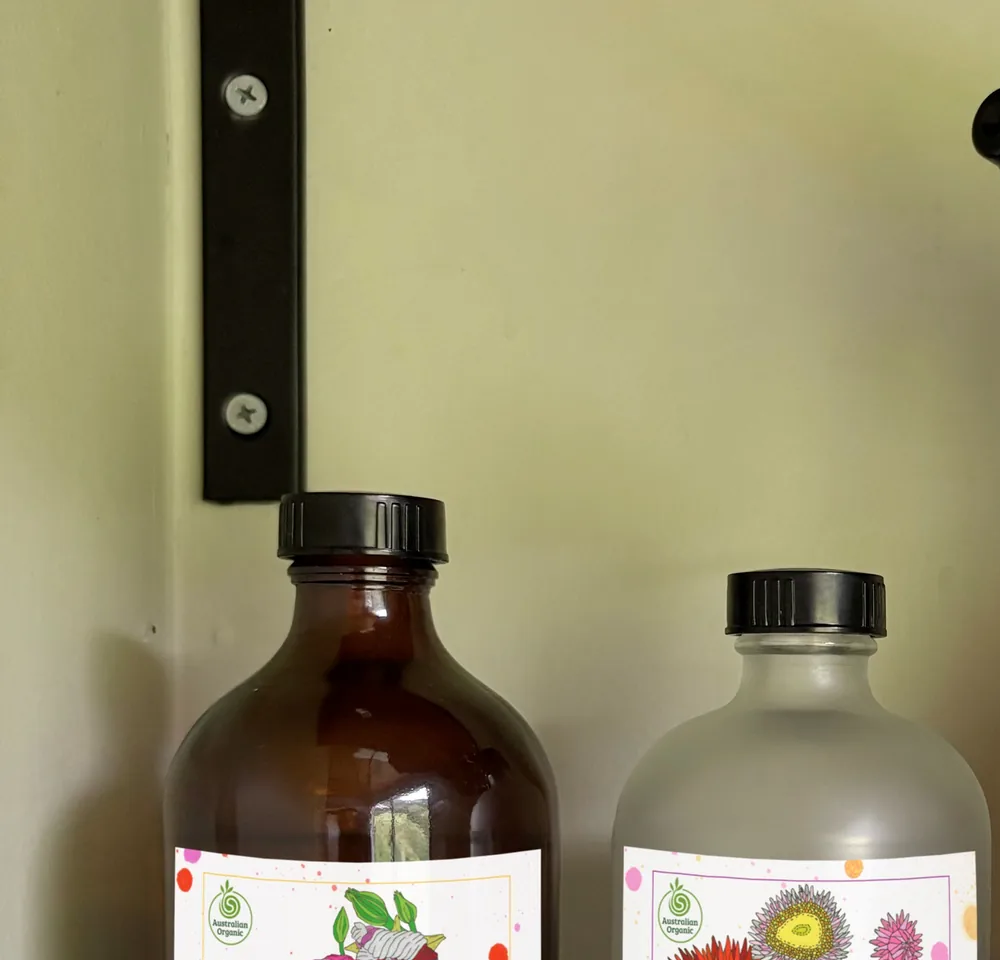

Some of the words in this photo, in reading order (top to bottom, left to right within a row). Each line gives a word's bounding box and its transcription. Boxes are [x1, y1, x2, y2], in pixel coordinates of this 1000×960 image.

[212, 918, 248, 929] Australian
[662, 917, 698, 926] Australian
[216, 928, 244, 938] Organic
[666, 926, 694, 935] Organic
